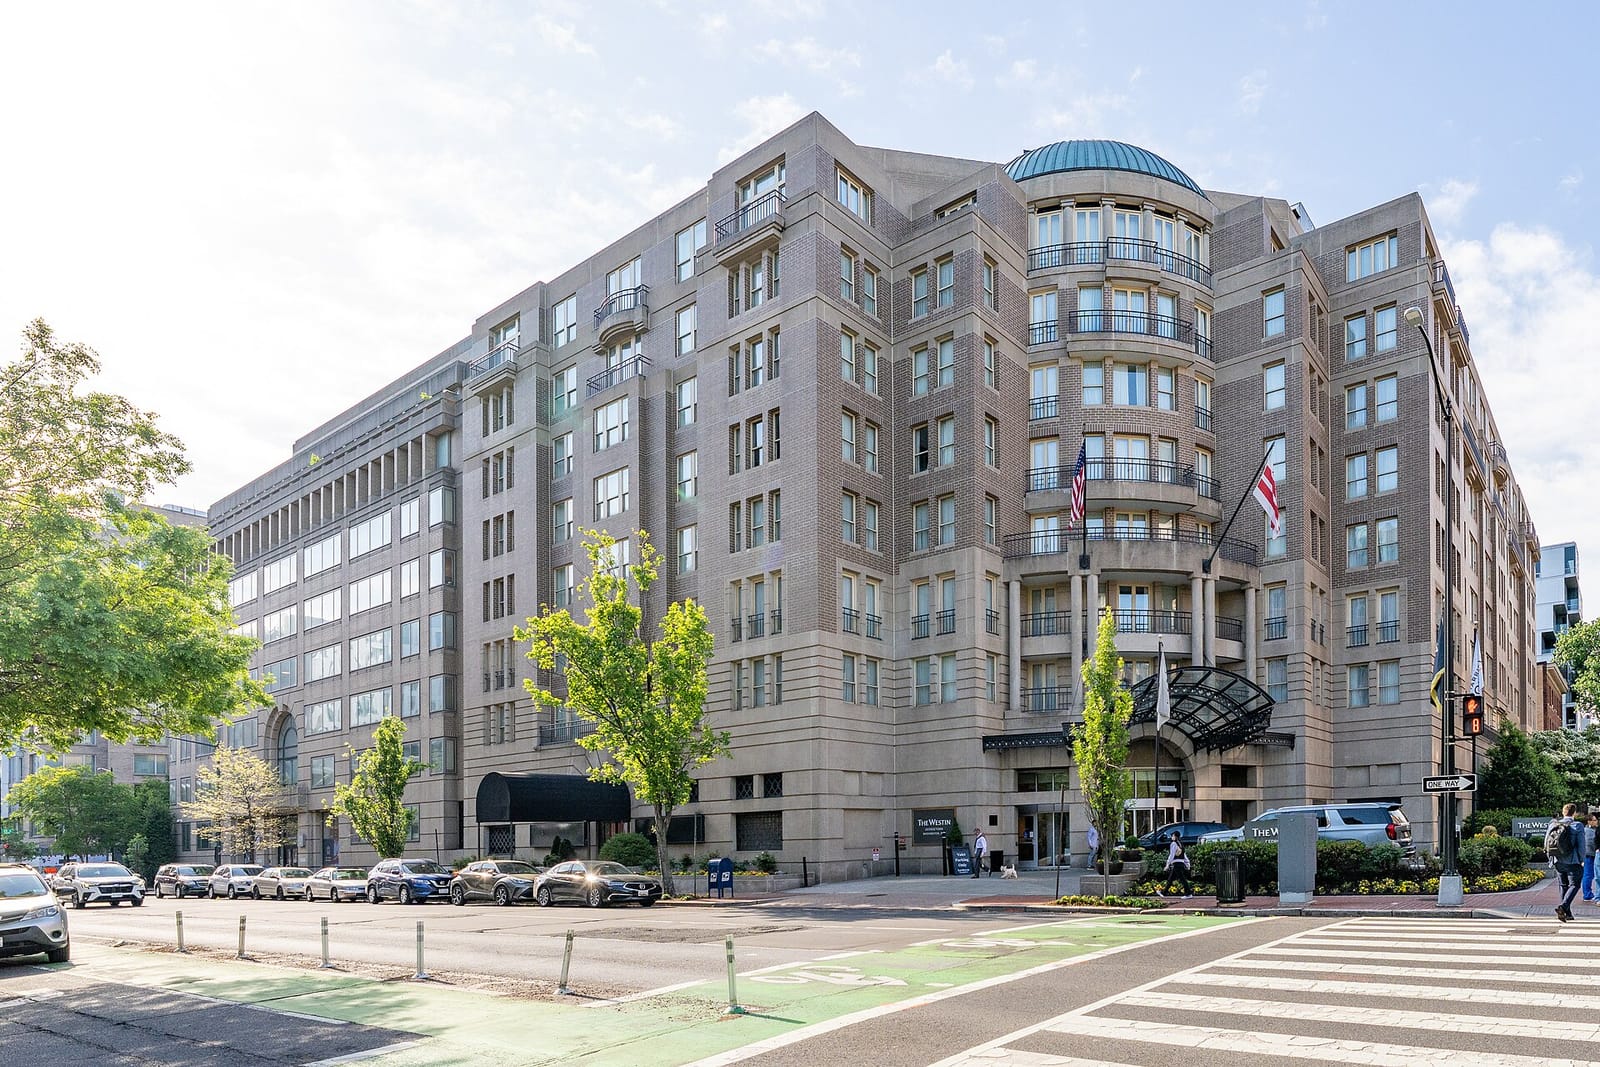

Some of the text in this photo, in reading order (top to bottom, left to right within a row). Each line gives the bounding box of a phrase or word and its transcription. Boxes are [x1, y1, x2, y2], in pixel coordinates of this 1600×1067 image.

[1472, 718, 1480, 733] 8
[917, 818, 952, 827] THE WESTIN
[1531, 821, 1549, 829] WEST
[1251, 827, 1270, 837] THE
